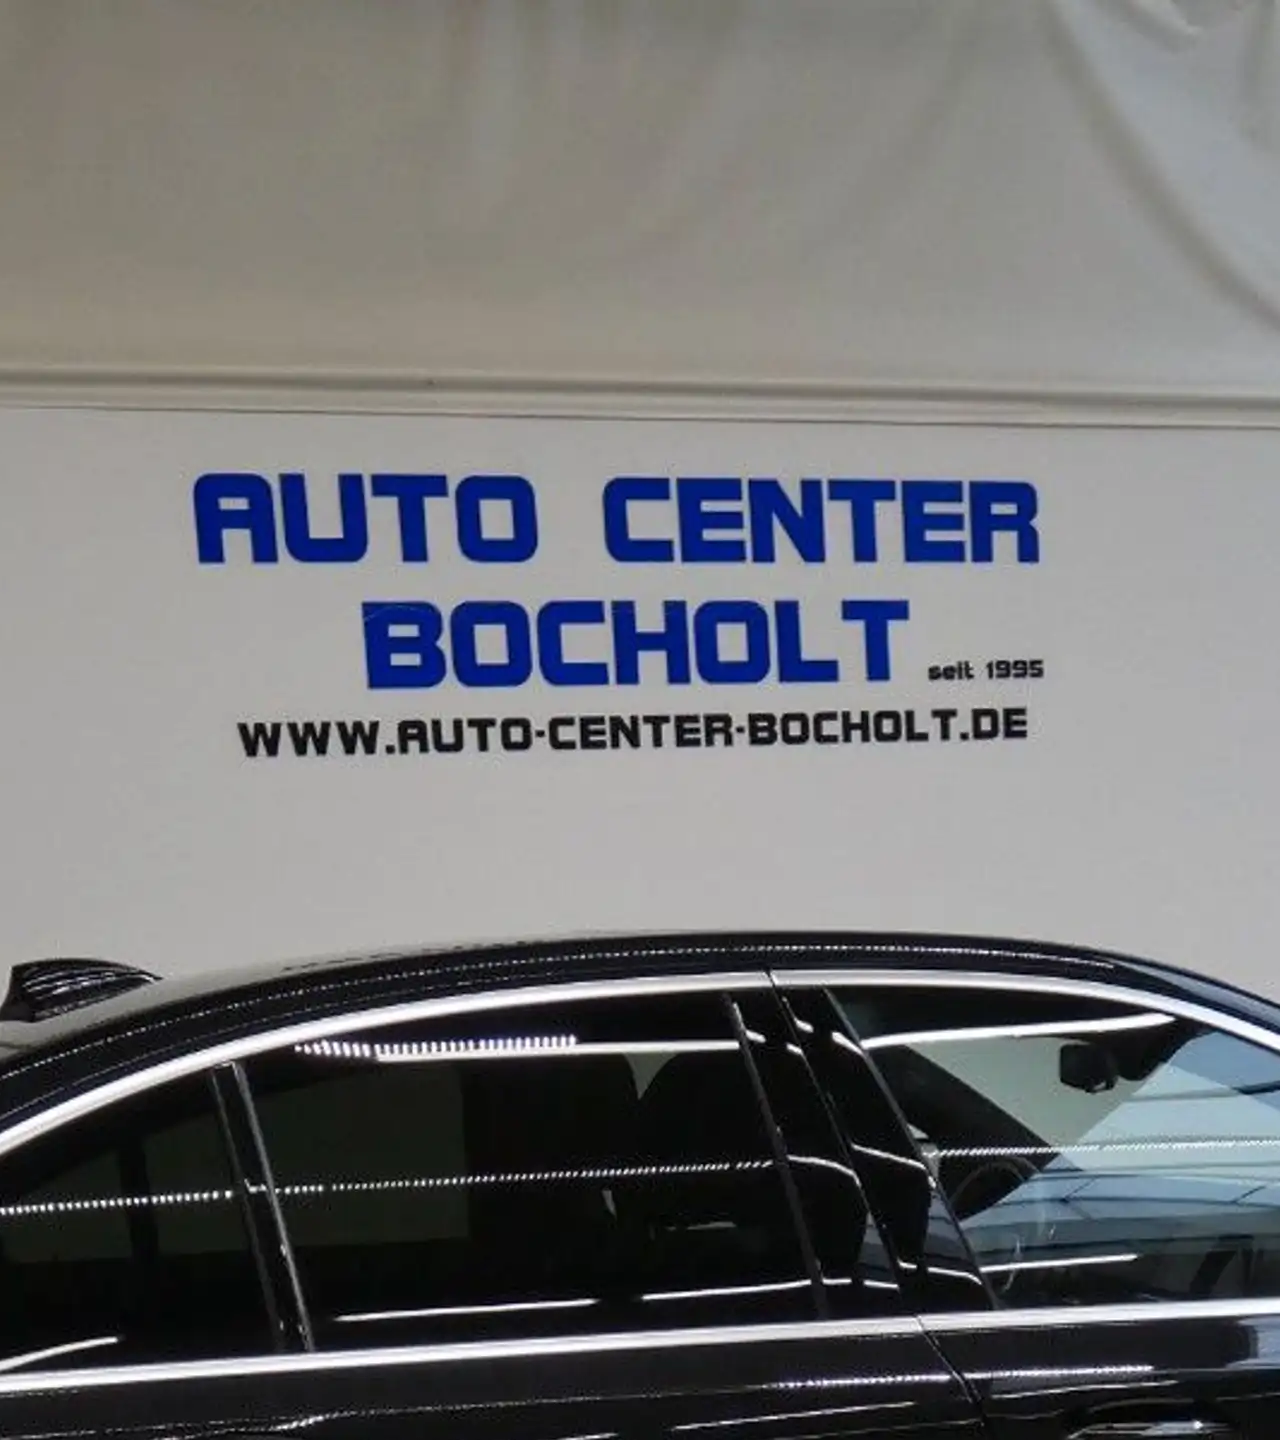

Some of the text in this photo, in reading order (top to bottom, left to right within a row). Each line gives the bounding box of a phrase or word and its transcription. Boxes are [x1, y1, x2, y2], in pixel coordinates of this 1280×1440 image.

[193, 473, 1040, 565] AUTO CENTER
[361, 599, 1044, 690] BOCHOLT seit 1995
[236, 707, 1028, 758] WWW.AUTO-CENTER-BOCHOLT.DE
